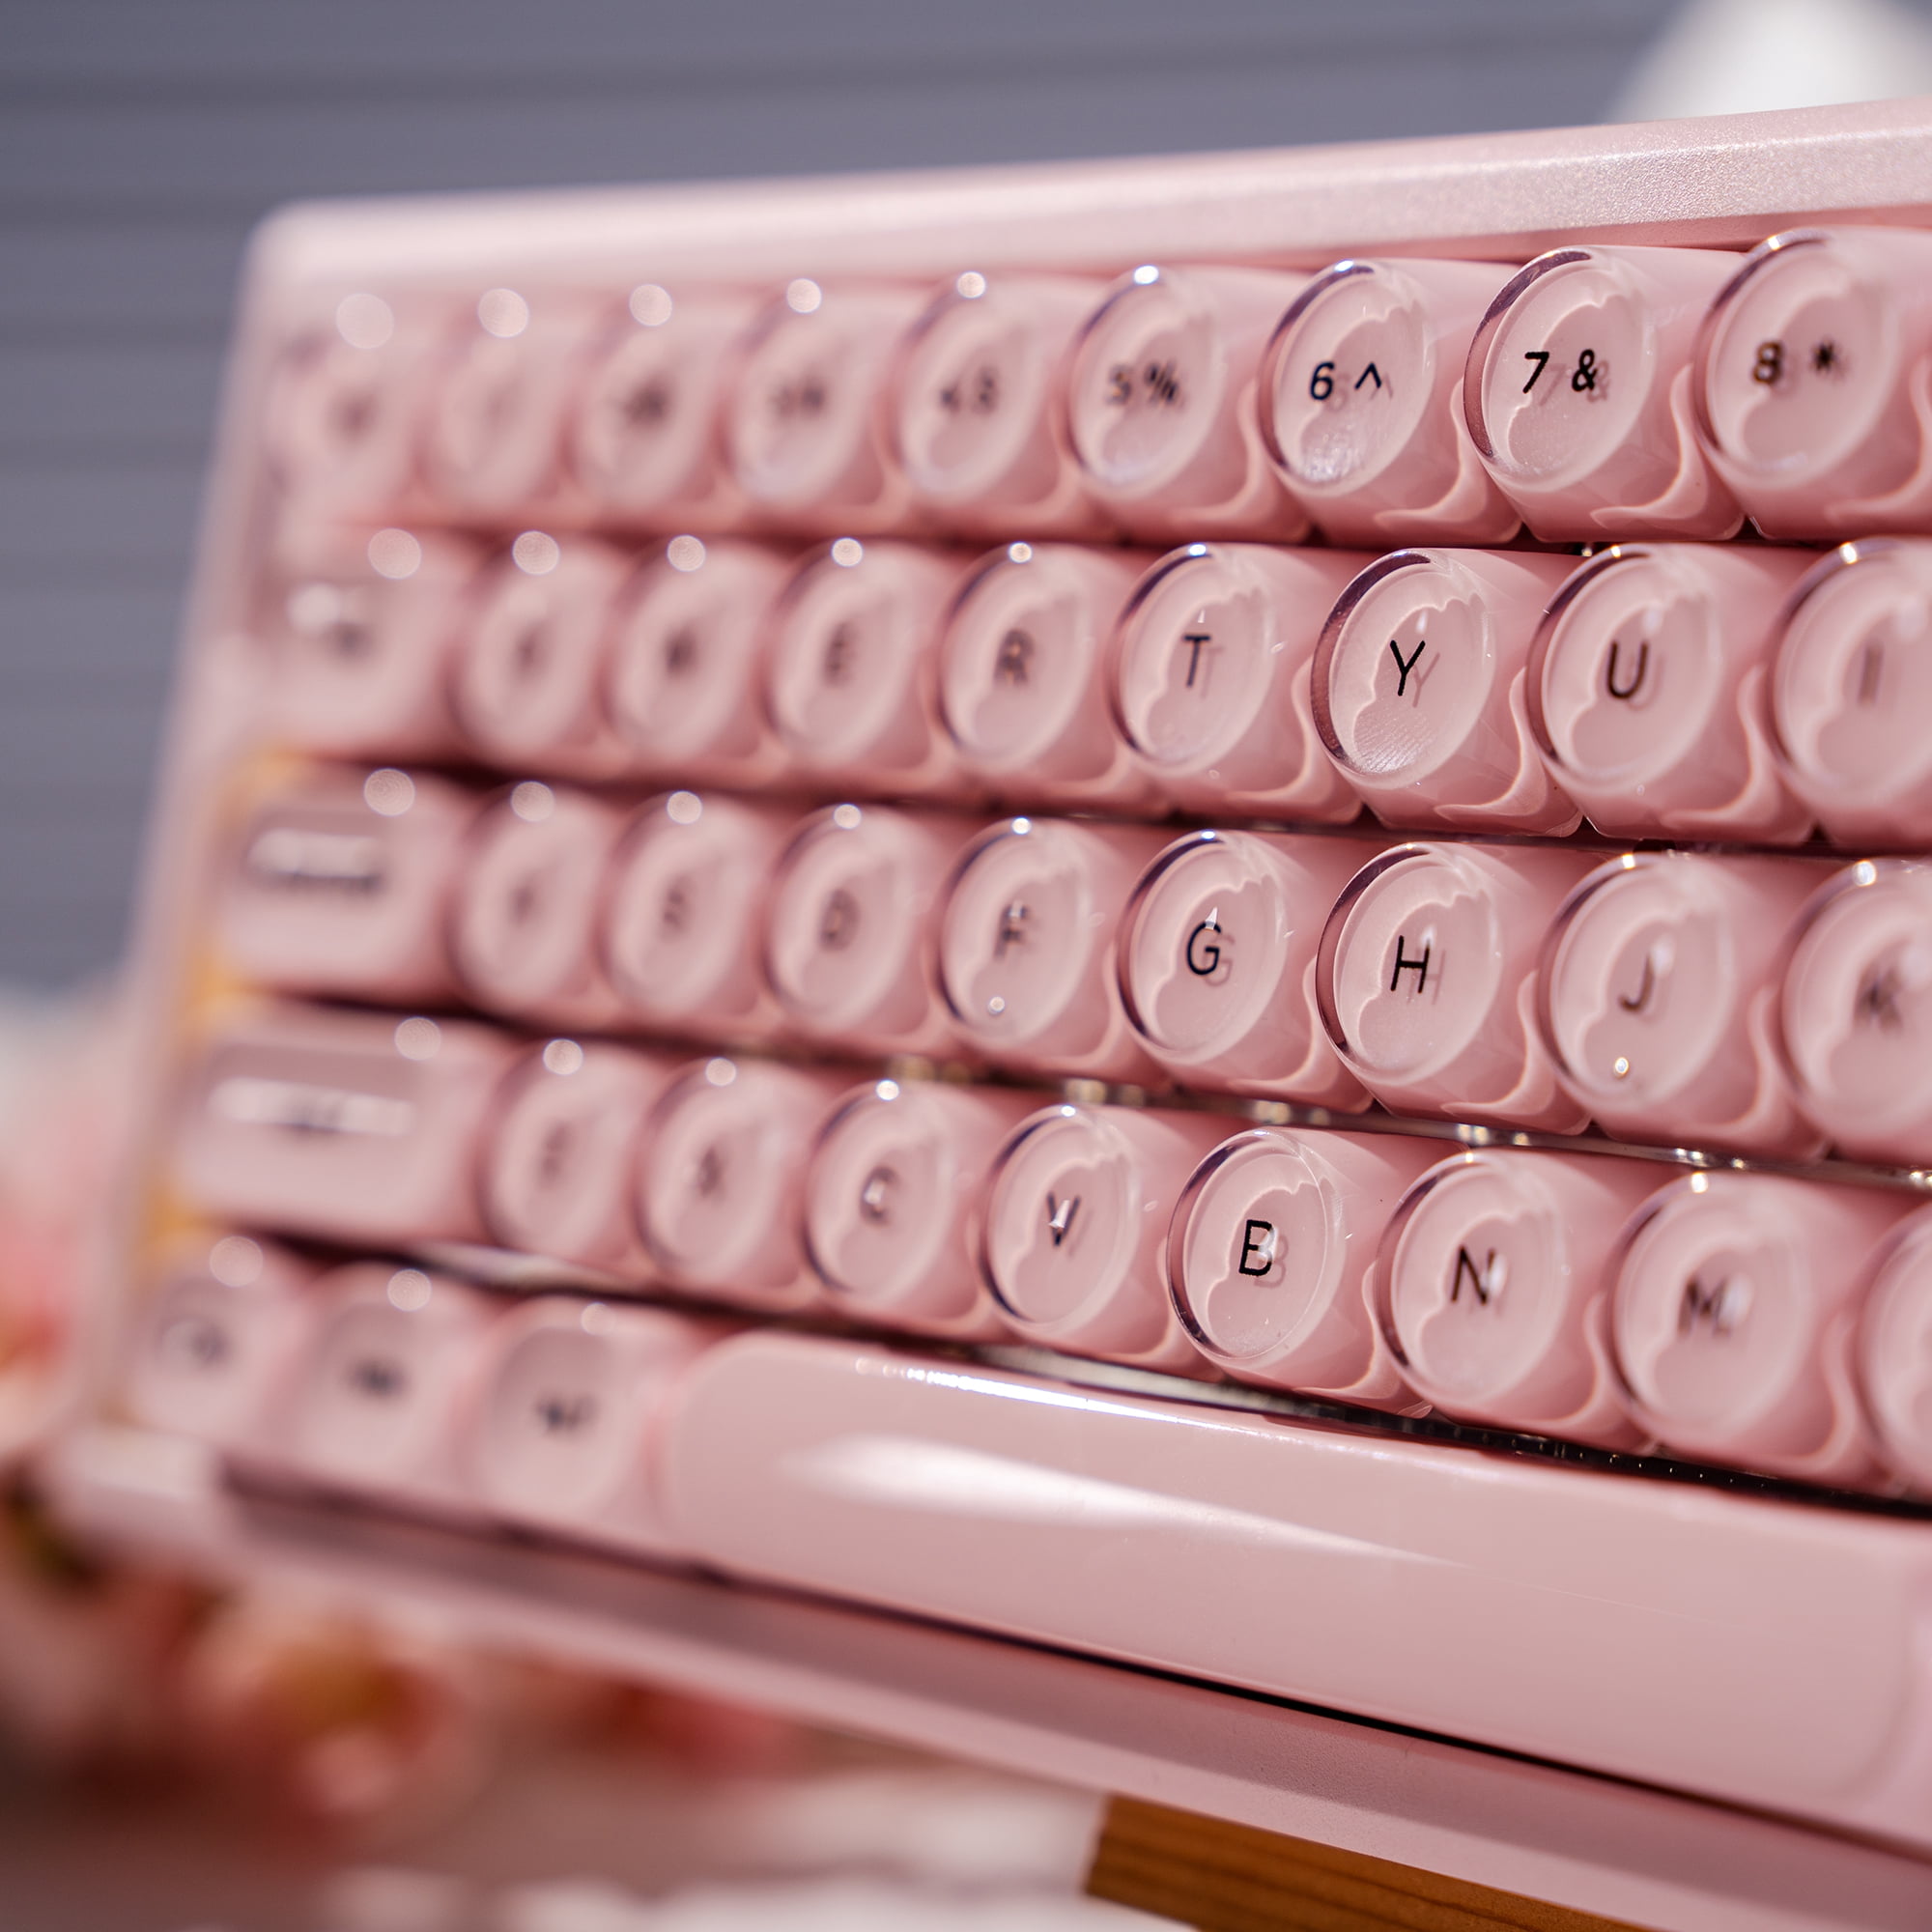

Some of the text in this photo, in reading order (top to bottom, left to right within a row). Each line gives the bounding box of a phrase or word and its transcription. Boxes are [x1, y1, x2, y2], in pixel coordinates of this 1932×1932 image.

[1310, 361, 1335, 401] 6
[1523, 350, 1598, 393] 7 &
[1751, 341, 1784, 385] 8
[994, 629, 1035, 686] R
[1181, 634, 1211, 688] T
[1389, 639, 1426, 696] Y
[1606, 639, 1649, 699] U
[1186, 921, 1222, 976] G
[1390, 935, 1432, 994] H
[1618, 949, 1657, 1011] J
[1046, 1191, 1082, 1246] V
[1238, 1219, 1274, 1277] B
[1450, 1245, 1496, 1305] N
[1677, 1275, 1733, 1339] M
